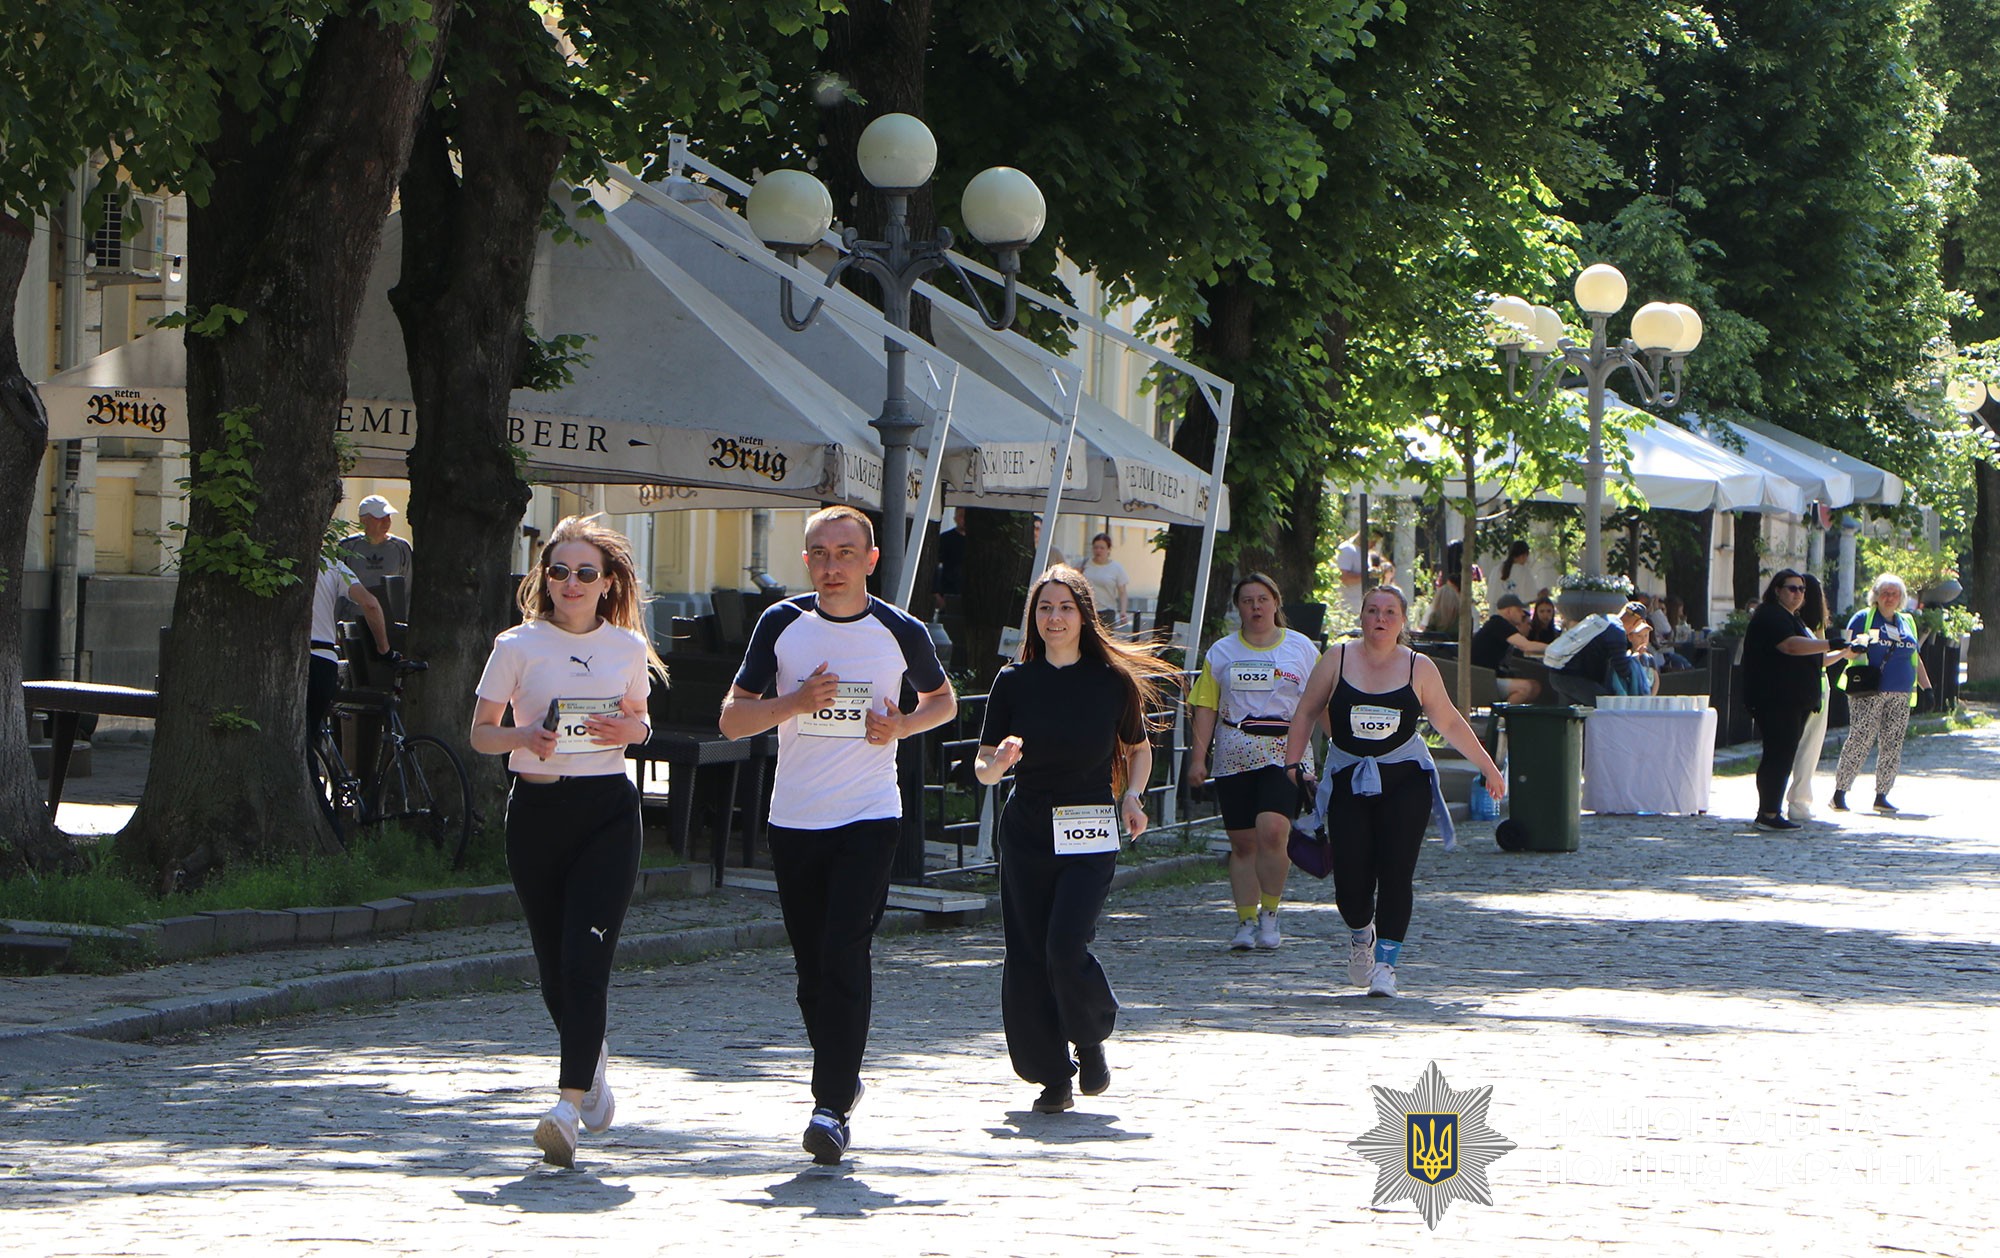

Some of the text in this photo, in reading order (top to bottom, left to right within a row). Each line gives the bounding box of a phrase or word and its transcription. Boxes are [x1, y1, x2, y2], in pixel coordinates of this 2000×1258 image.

[86, 394, 167, 433] Brug
[508, 417, 608, 453] BEER
[708, 437, 788, 482] Brug
[1002, 450, 1025, 474] BEER
[1237, 673, 1268, 681] 1032
[812, 708, 862, 721] 1033
[564, 724, 587, 736] 10
[1100, 807, 1112, 815] KM
[1063, 828, 1110, 840] 1034
